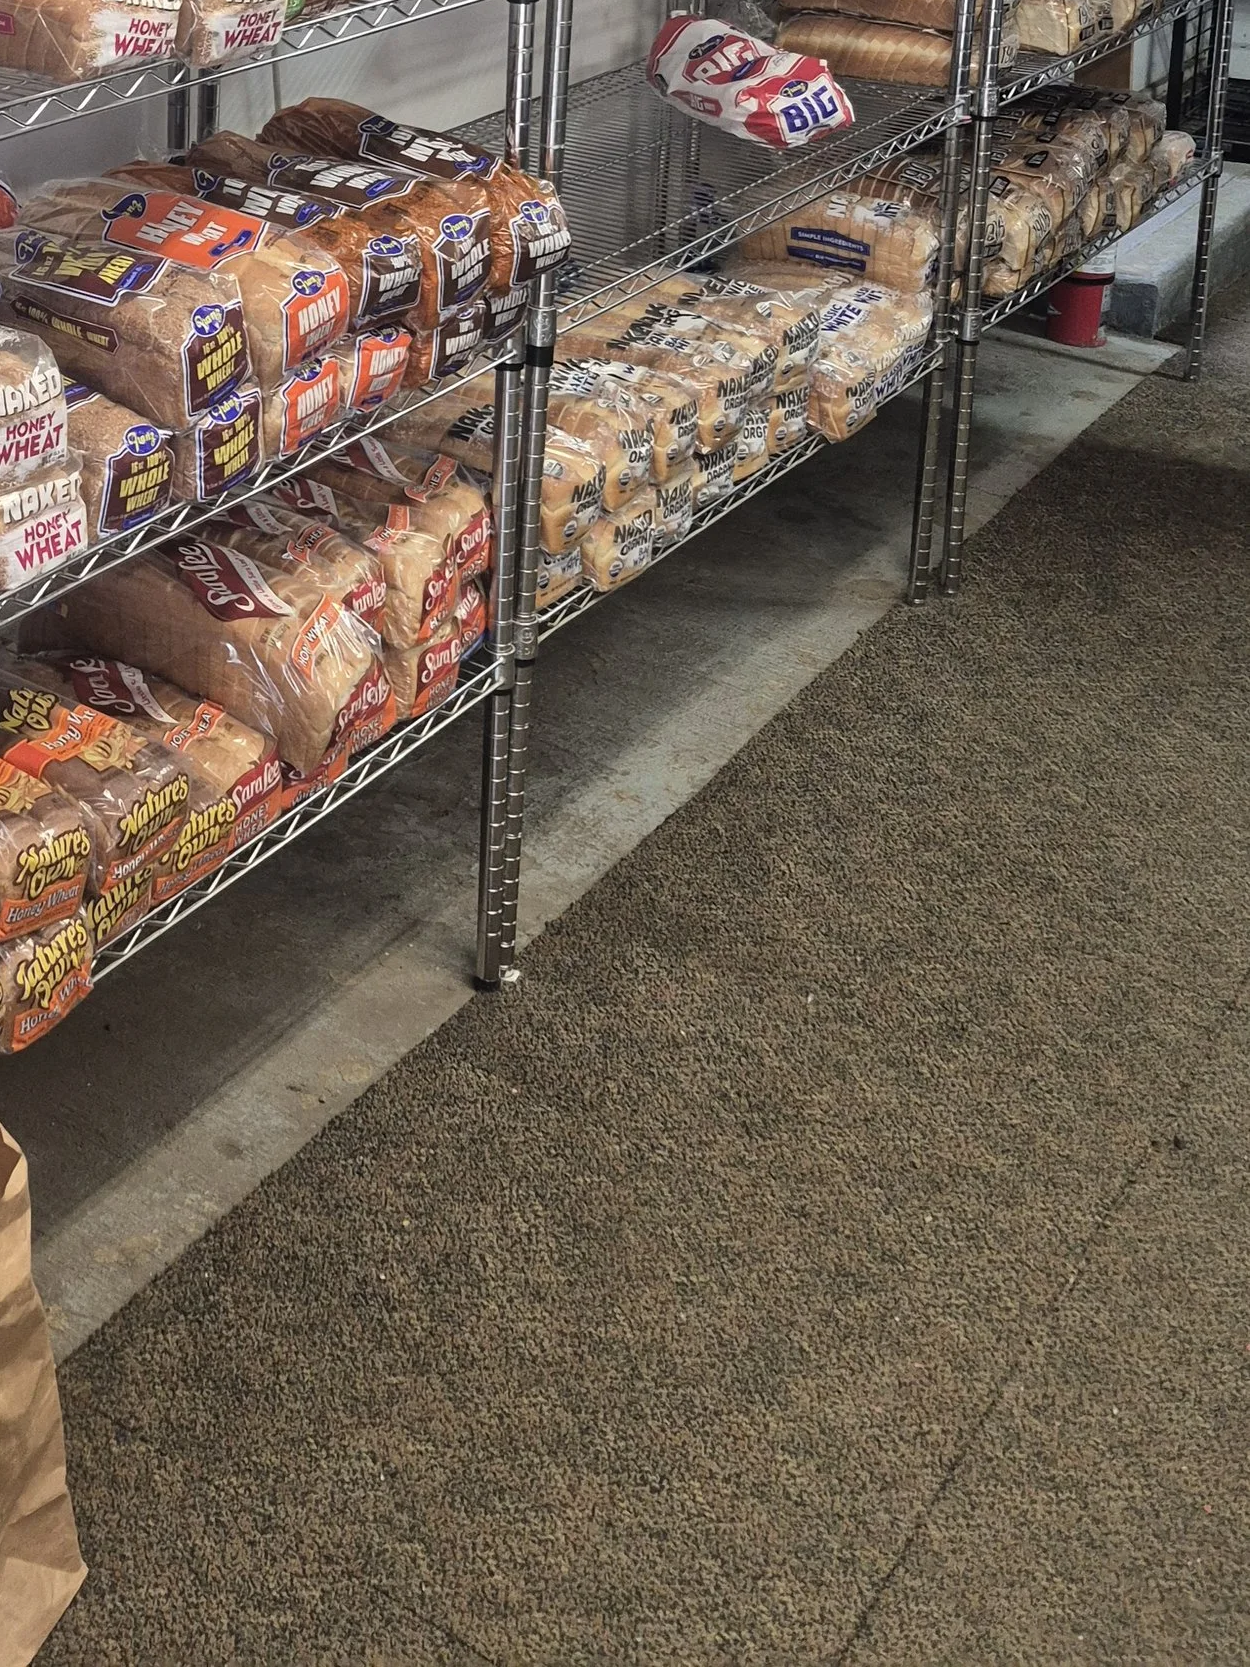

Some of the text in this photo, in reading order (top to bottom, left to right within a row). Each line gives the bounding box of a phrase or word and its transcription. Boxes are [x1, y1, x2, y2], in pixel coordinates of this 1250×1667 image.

[129, 18, 172, 40] HONEY
[223, 22, 282, 50] WHEAT
[238, 10, 279, 29] HONEY
[114, 34, 174, 57] WHEAT
[780, 85, 840, 134] BIG
[797, 230, 822, 242] SIMPLE
[298, 287, 341, 336] HONEY
[821, 304, 862, 333] WHITE
[197, 331, 243, 380] WHOLE
[206, 358, 236, 392] WHEAT
[298, 380, 333, 420] HONEY
[6, 411, 56, 442] HONEY
[214, 419, 255, 465] WHOLE
[120, 462, 170, 498] WHOLE
[224, 449, 250, 478] WHEAT
[126, 486, 159, 513] WHEAT
[24, 509, 70, 544] HONEY
[614, 509, 653, 544] NAKED
[15, 520, 82, 571] WHEAT
[119, 774, 188, 848] Nature's
[16, 825, 91, 884] Nature's
[178, 825, 221, 871] Own
[29, 854, 75, 898] Own
[6, 884, 80, 923] Honey Wheat
